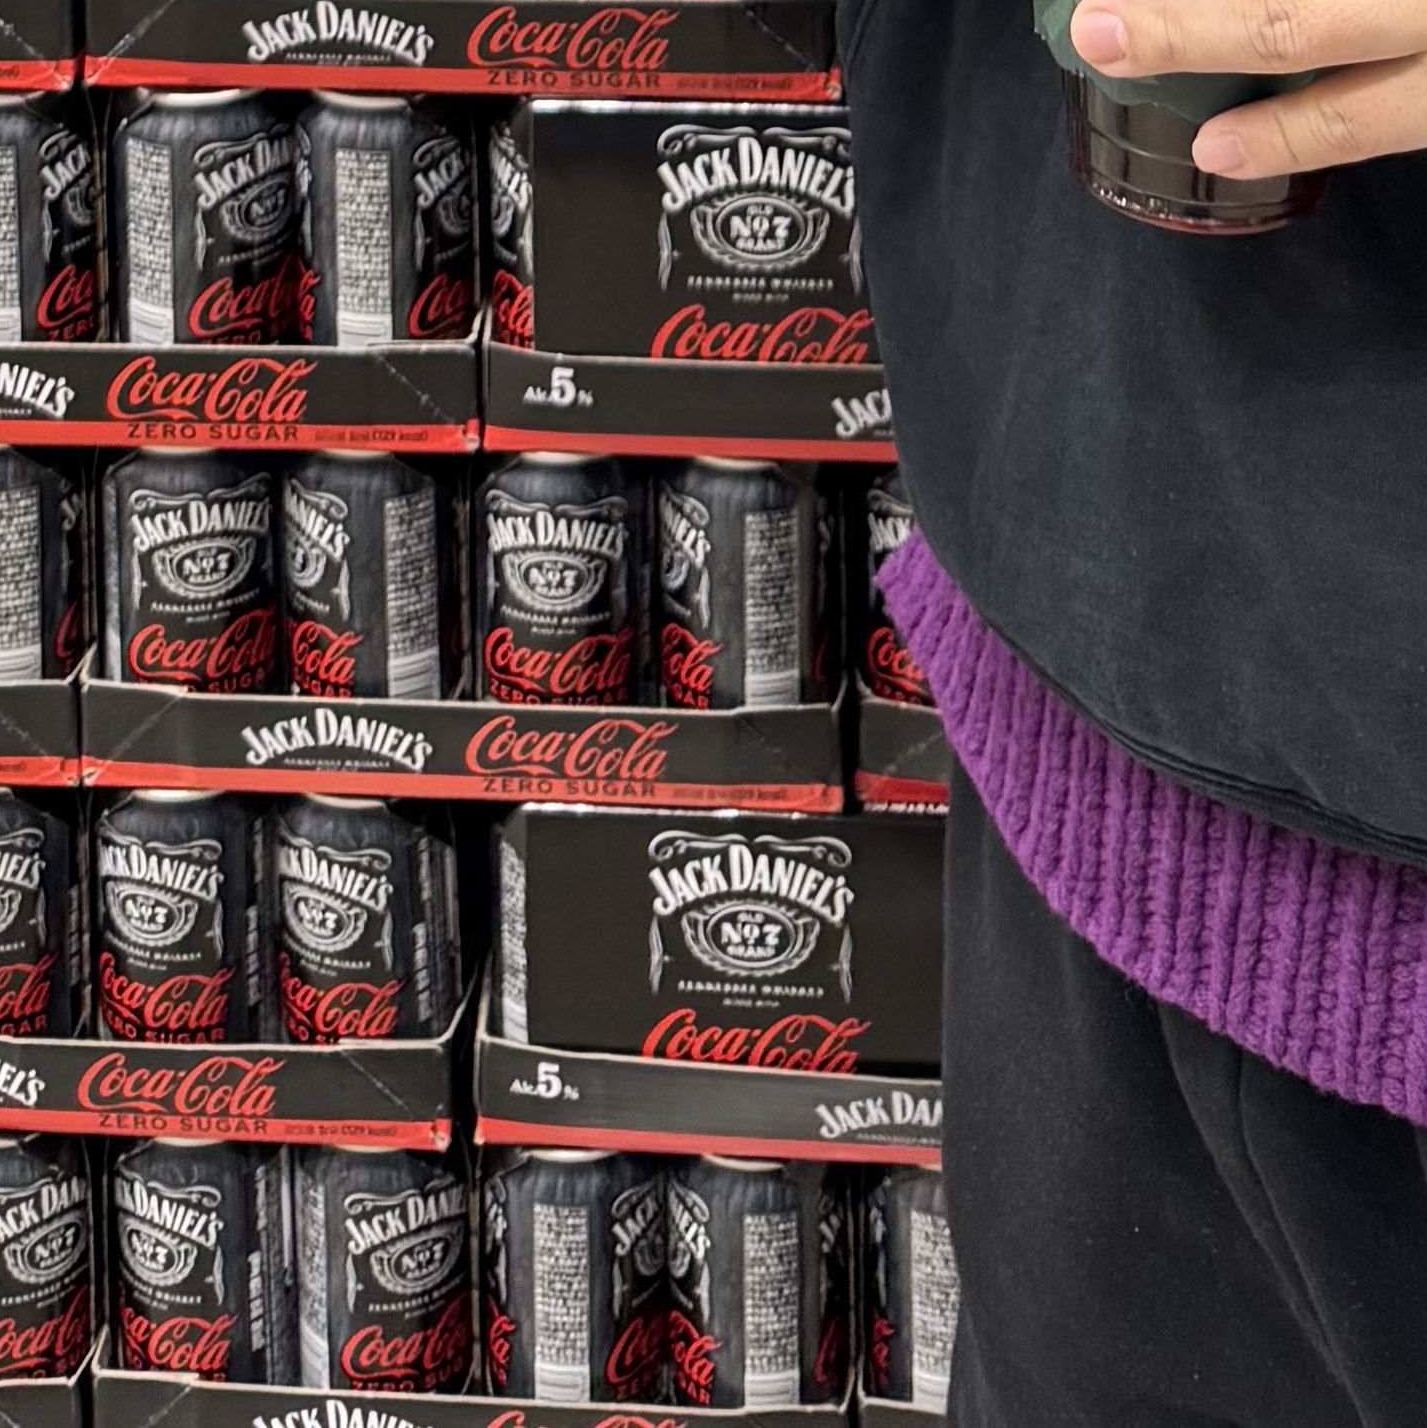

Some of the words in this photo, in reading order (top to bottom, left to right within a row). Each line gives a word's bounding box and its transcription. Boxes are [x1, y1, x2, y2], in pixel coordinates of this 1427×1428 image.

[241, 12, 320, 65] JACK
[317, 0, 435, 65] DANIEL'S
[466, 5, 680, 70] Coca-Cola
[487, 69, 557, 87] ZERO
[569, 71, 661, 89] SUGAR
[106, 355, 319, 423] Coca-Cola
[127, 422, 196, 441] ZERO
[208, 423, 298, 443] SUGAR
[464, 714, 679, 783] Coca-Cola
[482, 777, 554, 796] ZERO
[566, 778, 656, 799] SUGAR
[648, 855, 728, 917] JACK
[726, 843, 854, 925] DANIEL'S
[76, 1052, 285, 1118] Coca-Cola
[98, 1113, 167, 1132] ZERO
[180, 1115, 269, 1135] SUGAR
